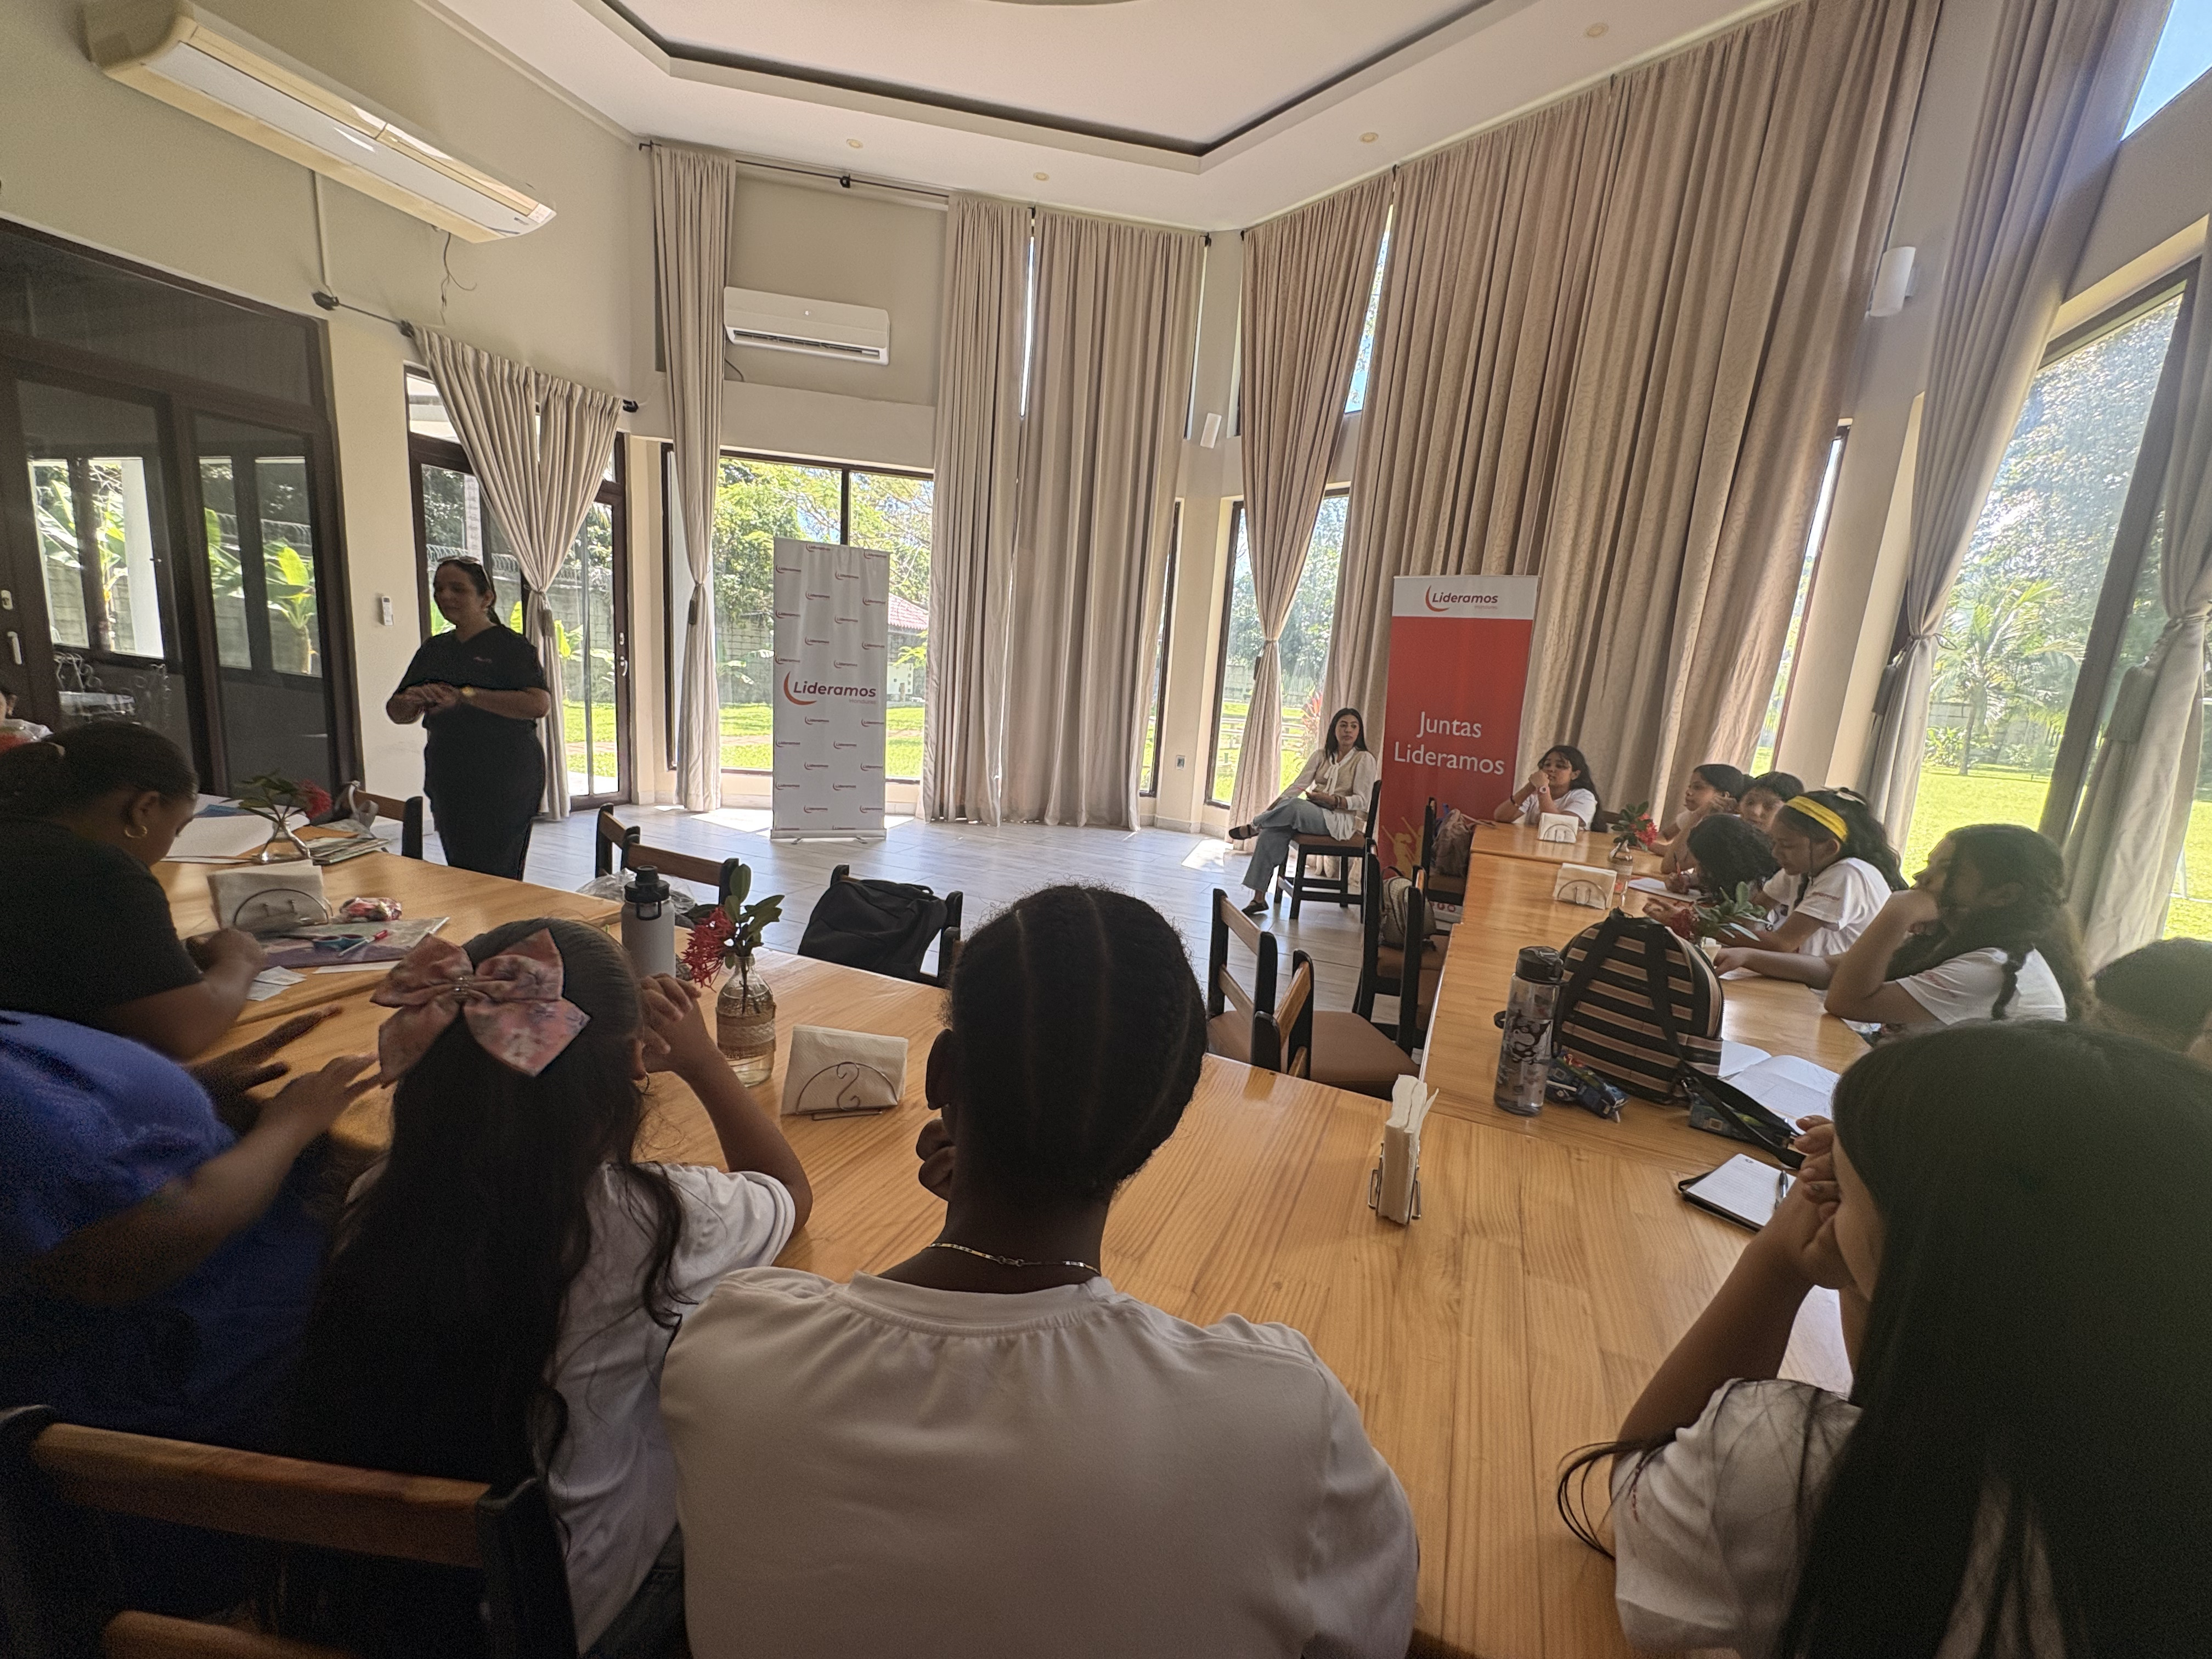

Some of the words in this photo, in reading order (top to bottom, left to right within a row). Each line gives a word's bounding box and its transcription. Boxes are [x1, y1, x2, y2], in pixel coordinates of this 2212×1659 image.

[1432, 592, 1498, 603] Lideramos
[793, 681, 876, 697] Lideramos
[1417, 711, 1482, 738] Juntas
[1394, 742, 1505, 775] Lideramos
